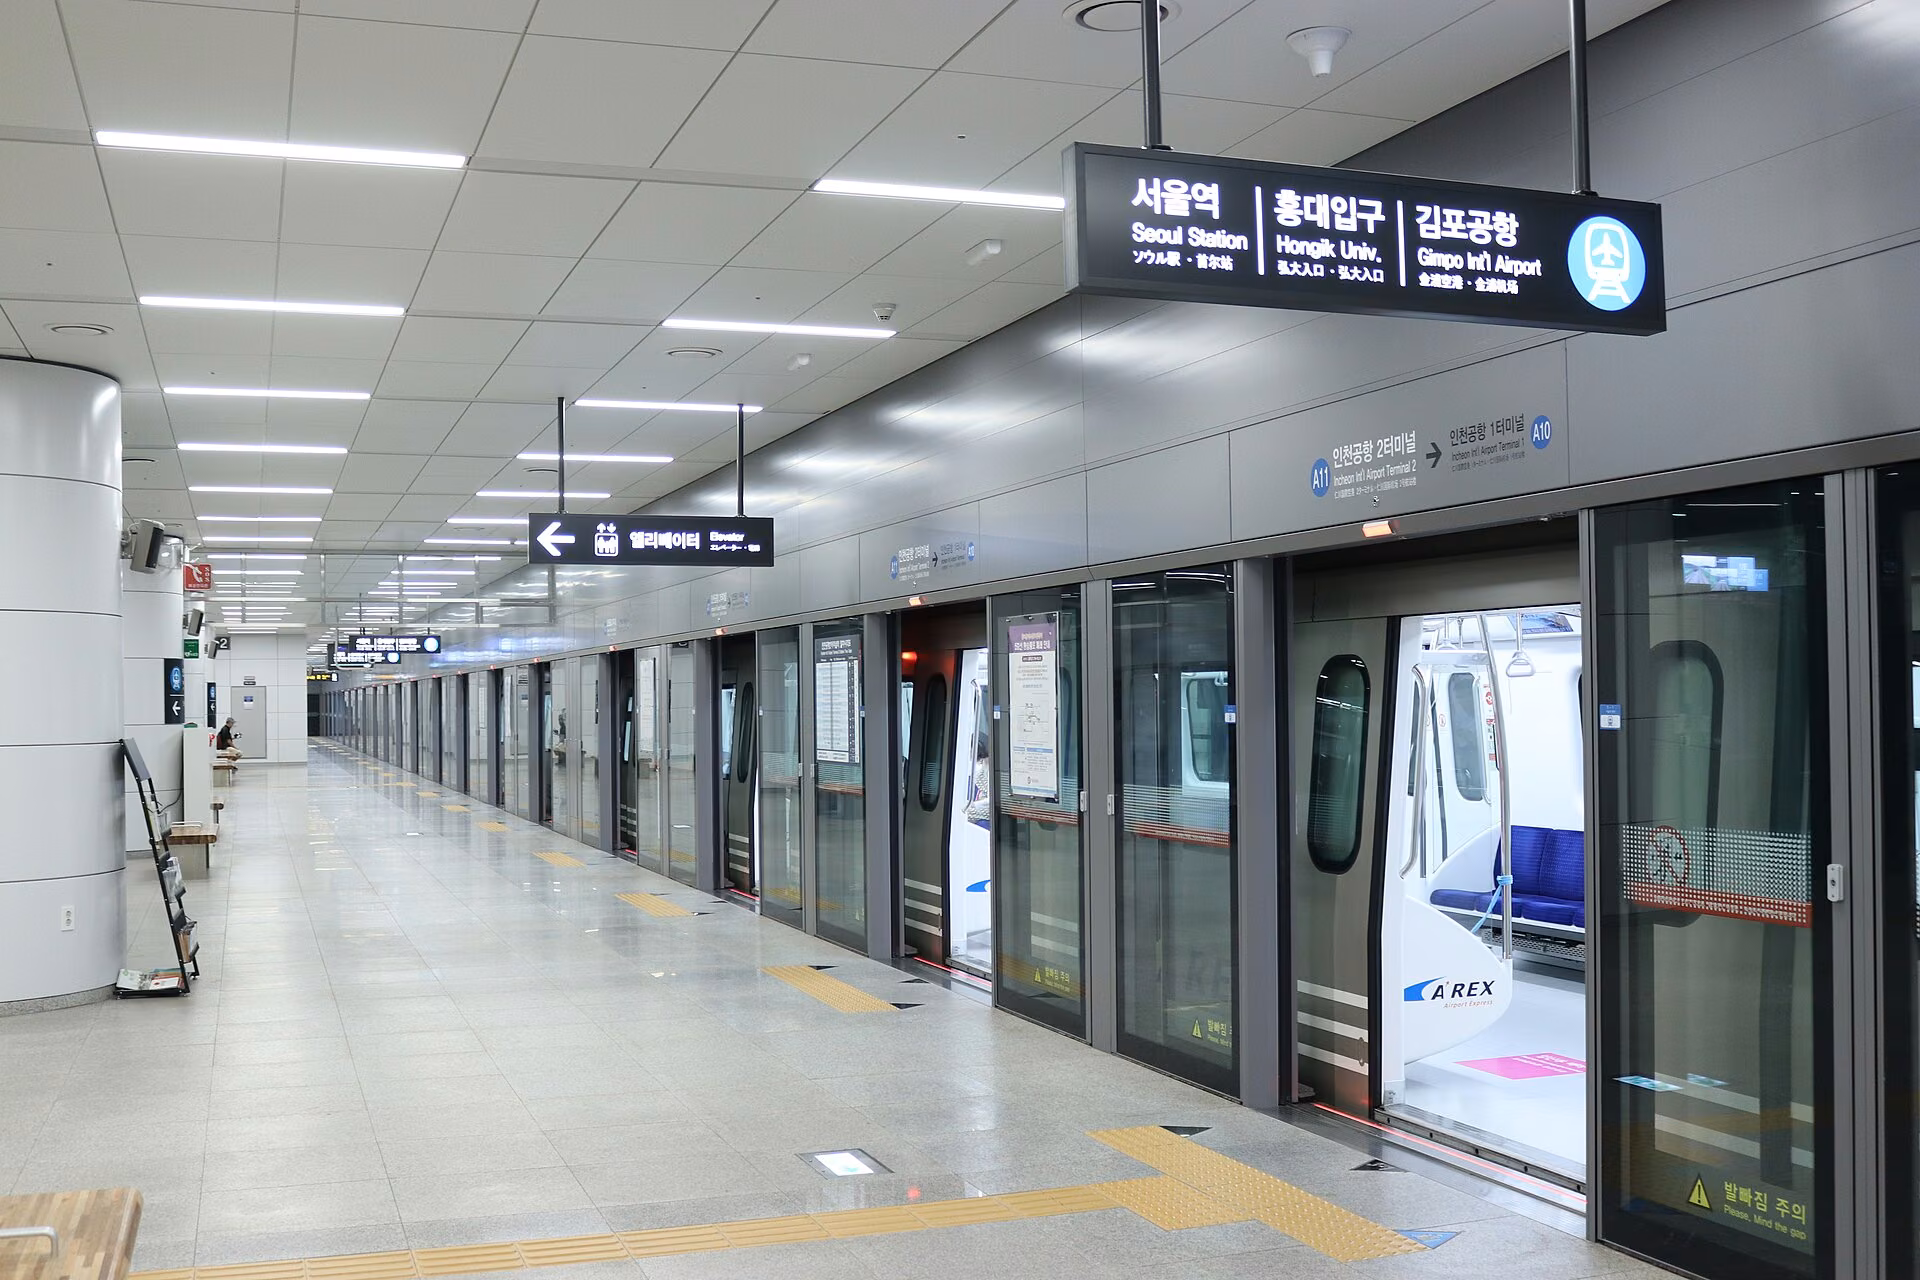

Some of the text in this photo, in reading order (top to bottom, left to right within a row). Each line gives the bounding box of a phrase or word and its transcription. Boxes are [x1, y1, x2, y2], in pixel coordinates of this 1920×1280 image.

[1131, 177, 1220, 220] 서울역
[1273, 189, 1386, 234] 홍대입구
[1132, 221, 1249, 251] Seoul Station
[1415, 204, 1520, 248] 김포공항
[1276, 234, 1382, 264] Hongik Univ.
[1417, 246, 1543, 277] Gimpo Int'l Airport
[1449, 413, 1525, 447] 인천공항 1터미널
[1533, 420, 1551, 442] A10
[1332, 430, 1417, 469] 인천공항 2터미널
[1312, 466, 1329, 490] A11
[1333, 472, 1355, 487] Incheon
[1366, 465, 1386, 481] Airport
[1386, 461, 1411, 477] Terminal
[1411, 459, 1417, 472] 2
[629, 531, 700, 550] 엘리베이터
[219, 637, 228, 649] 2
[1443, 999, 1493, 1009] Airport Express
[1723, 1181, 1806, 1226] 발빠짐 주의
[1753, 1214, 1773, 1229] Mind
[1774, 1221, 1788, 1234] the
[1789, 1228, 1807, 1240] gap
